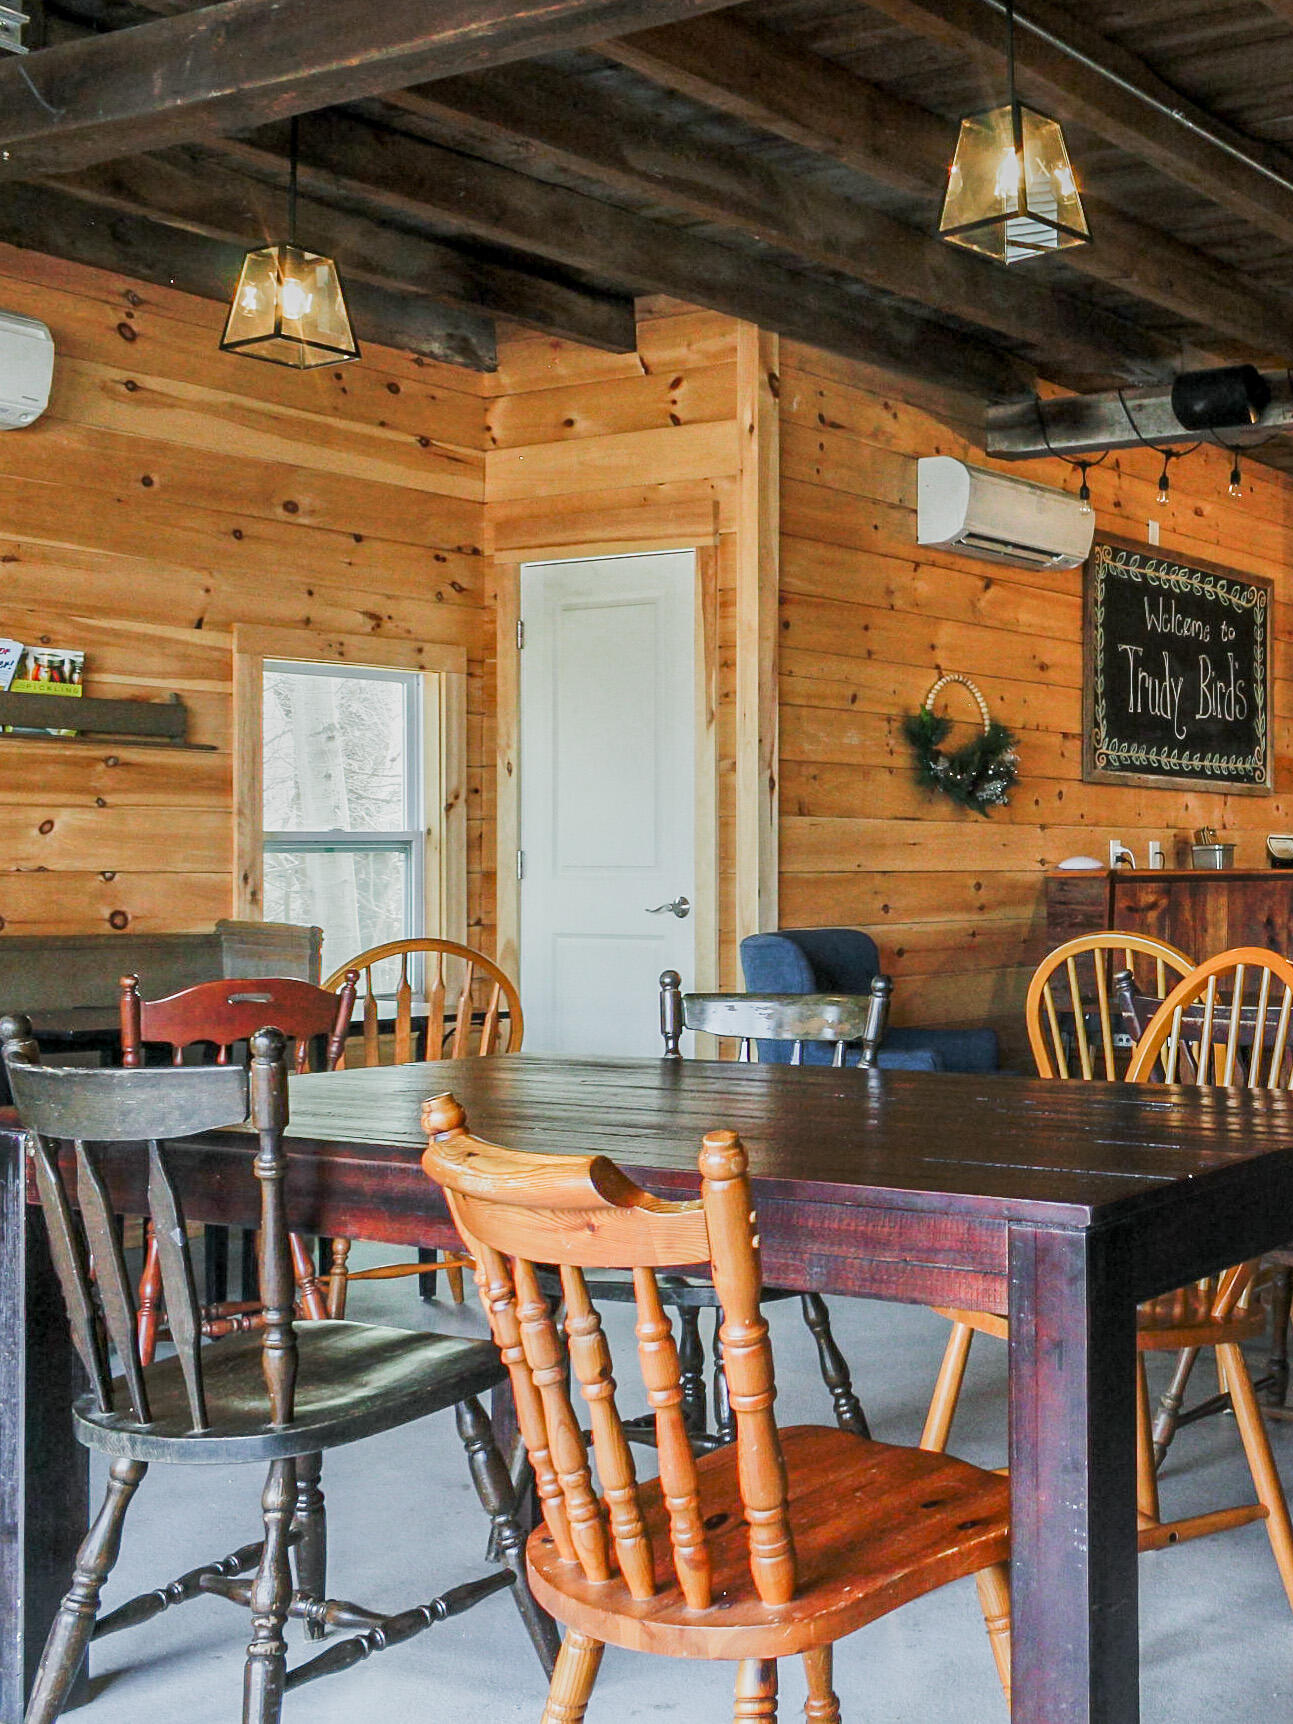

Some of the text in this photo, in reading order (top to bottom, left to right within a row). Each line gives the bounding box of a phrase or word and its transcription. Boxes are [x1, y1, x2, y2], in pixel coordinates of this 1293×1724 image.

[1144, 596, 1236, 642] Welcome to
[1118, 644, 1247, 739] Trudy Bird's
